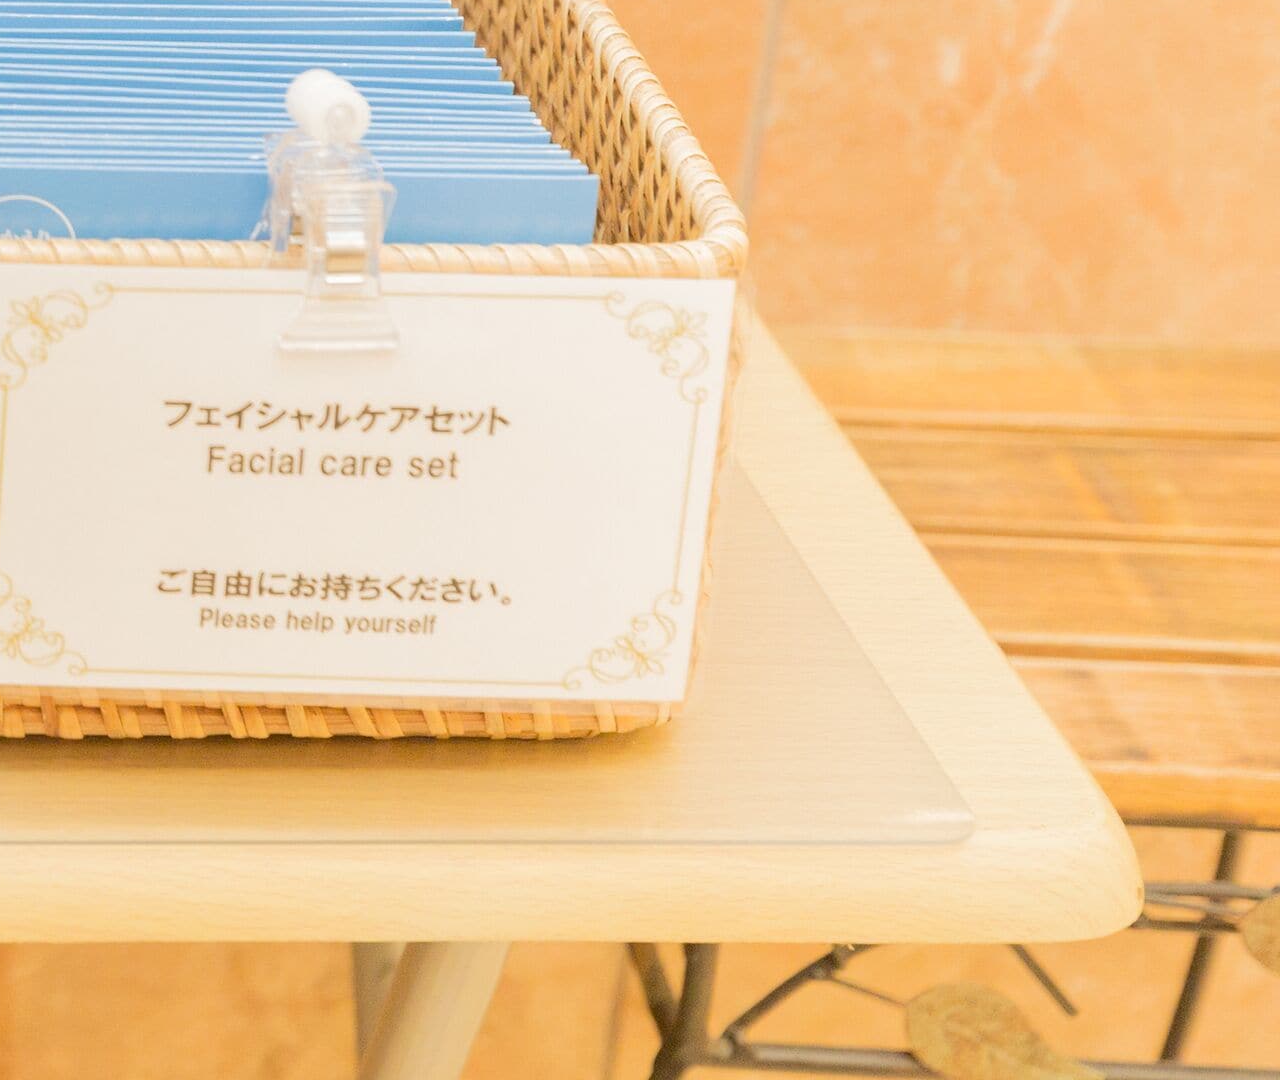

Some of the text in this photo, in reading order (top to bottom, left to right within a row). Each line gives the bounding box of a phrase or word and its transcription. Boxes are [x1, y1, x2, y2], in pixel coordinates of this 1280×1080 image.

[164, 401, 510, 435] フェイシャルケアセット
[208, 446, 459, 478] Facial care set
[157, 569, 510, 605] ご自由にお持ちください。
[200, 607, 437, 636] Please help yourself
